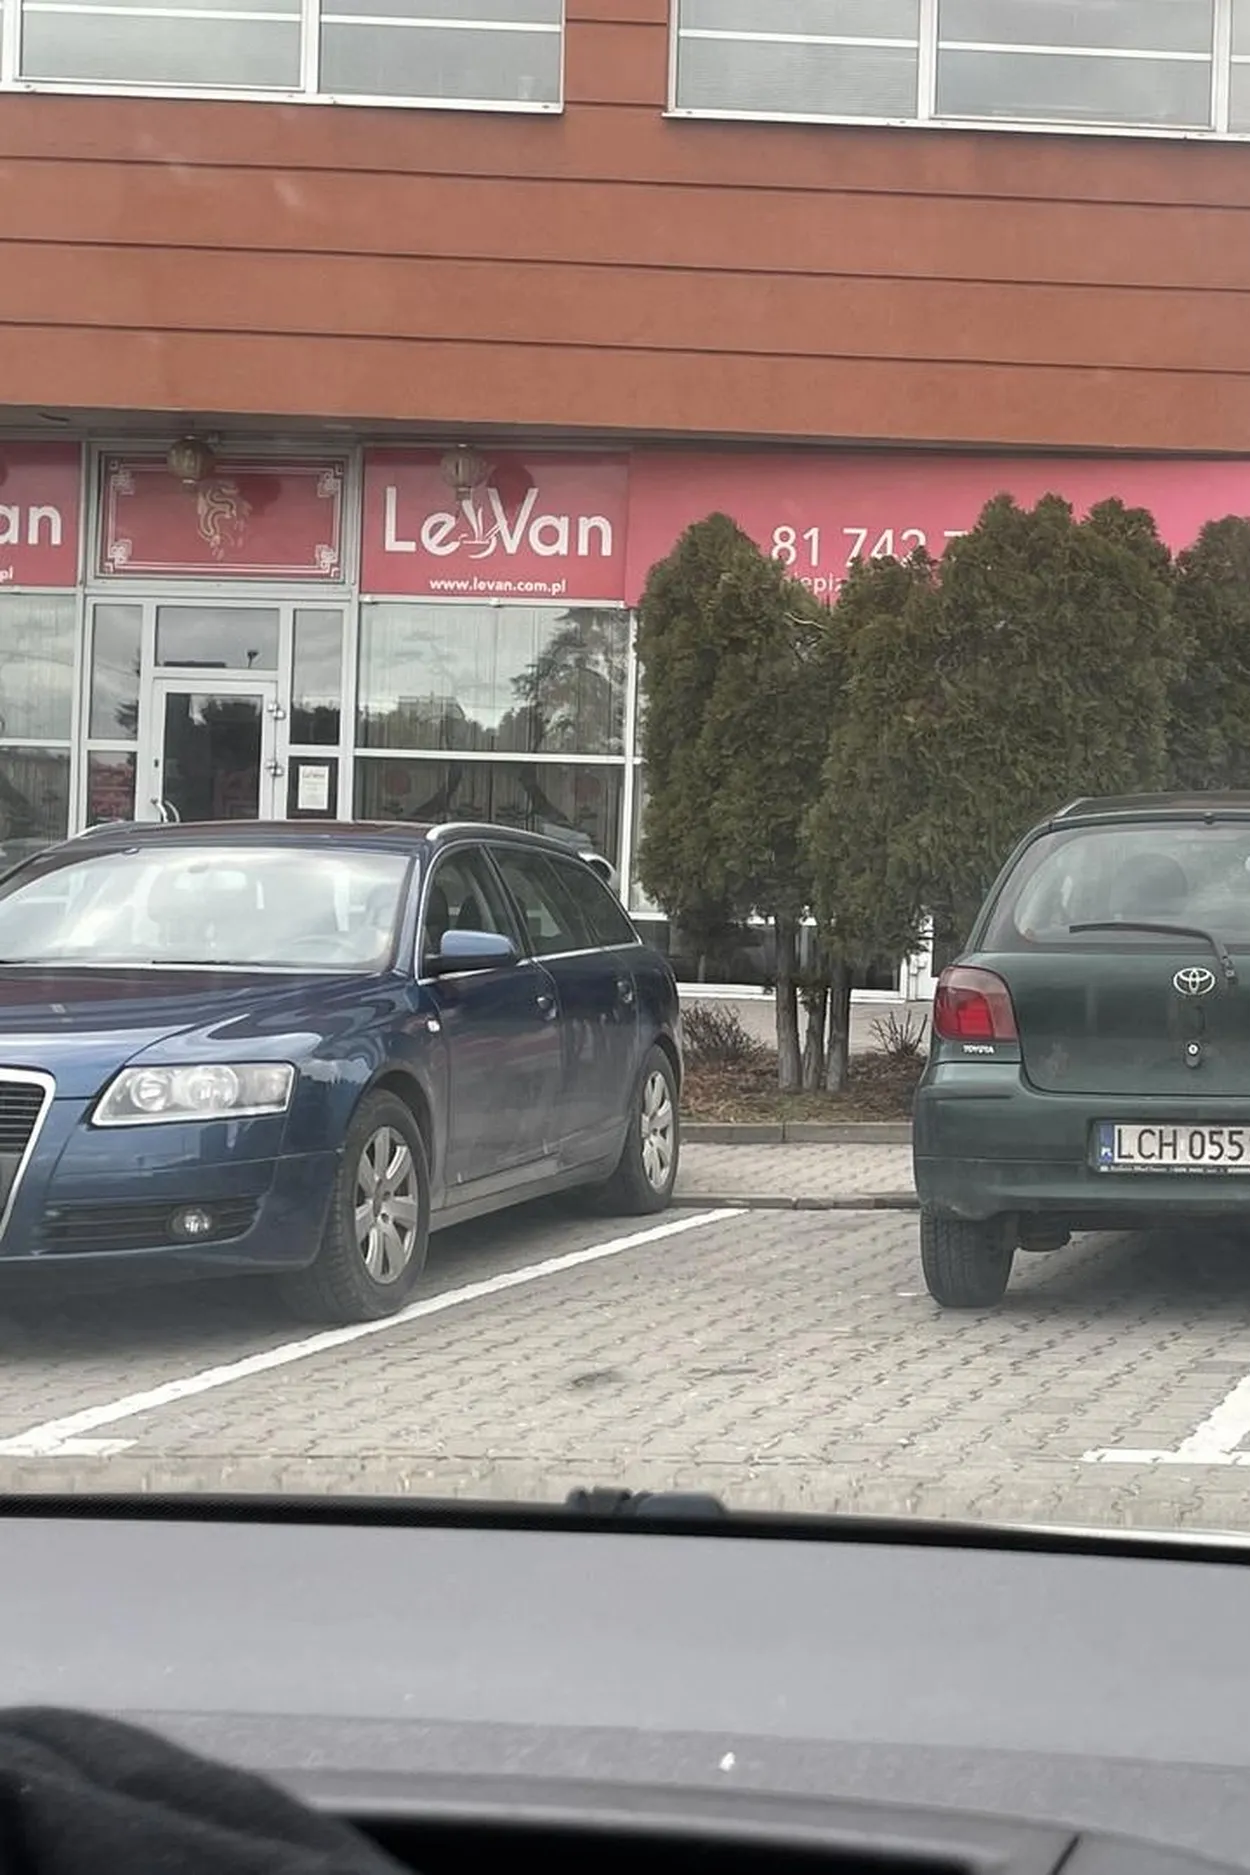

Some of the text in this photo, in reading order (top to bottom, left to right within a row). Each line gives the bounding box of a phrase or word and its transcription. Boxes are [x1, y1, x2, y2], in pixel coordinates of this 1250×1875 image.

[771, 526, 820, 567] 81
[430, 577, 566, 595] www.levan.com.pl
[1117, 1128, 1178, 1160] LCH
